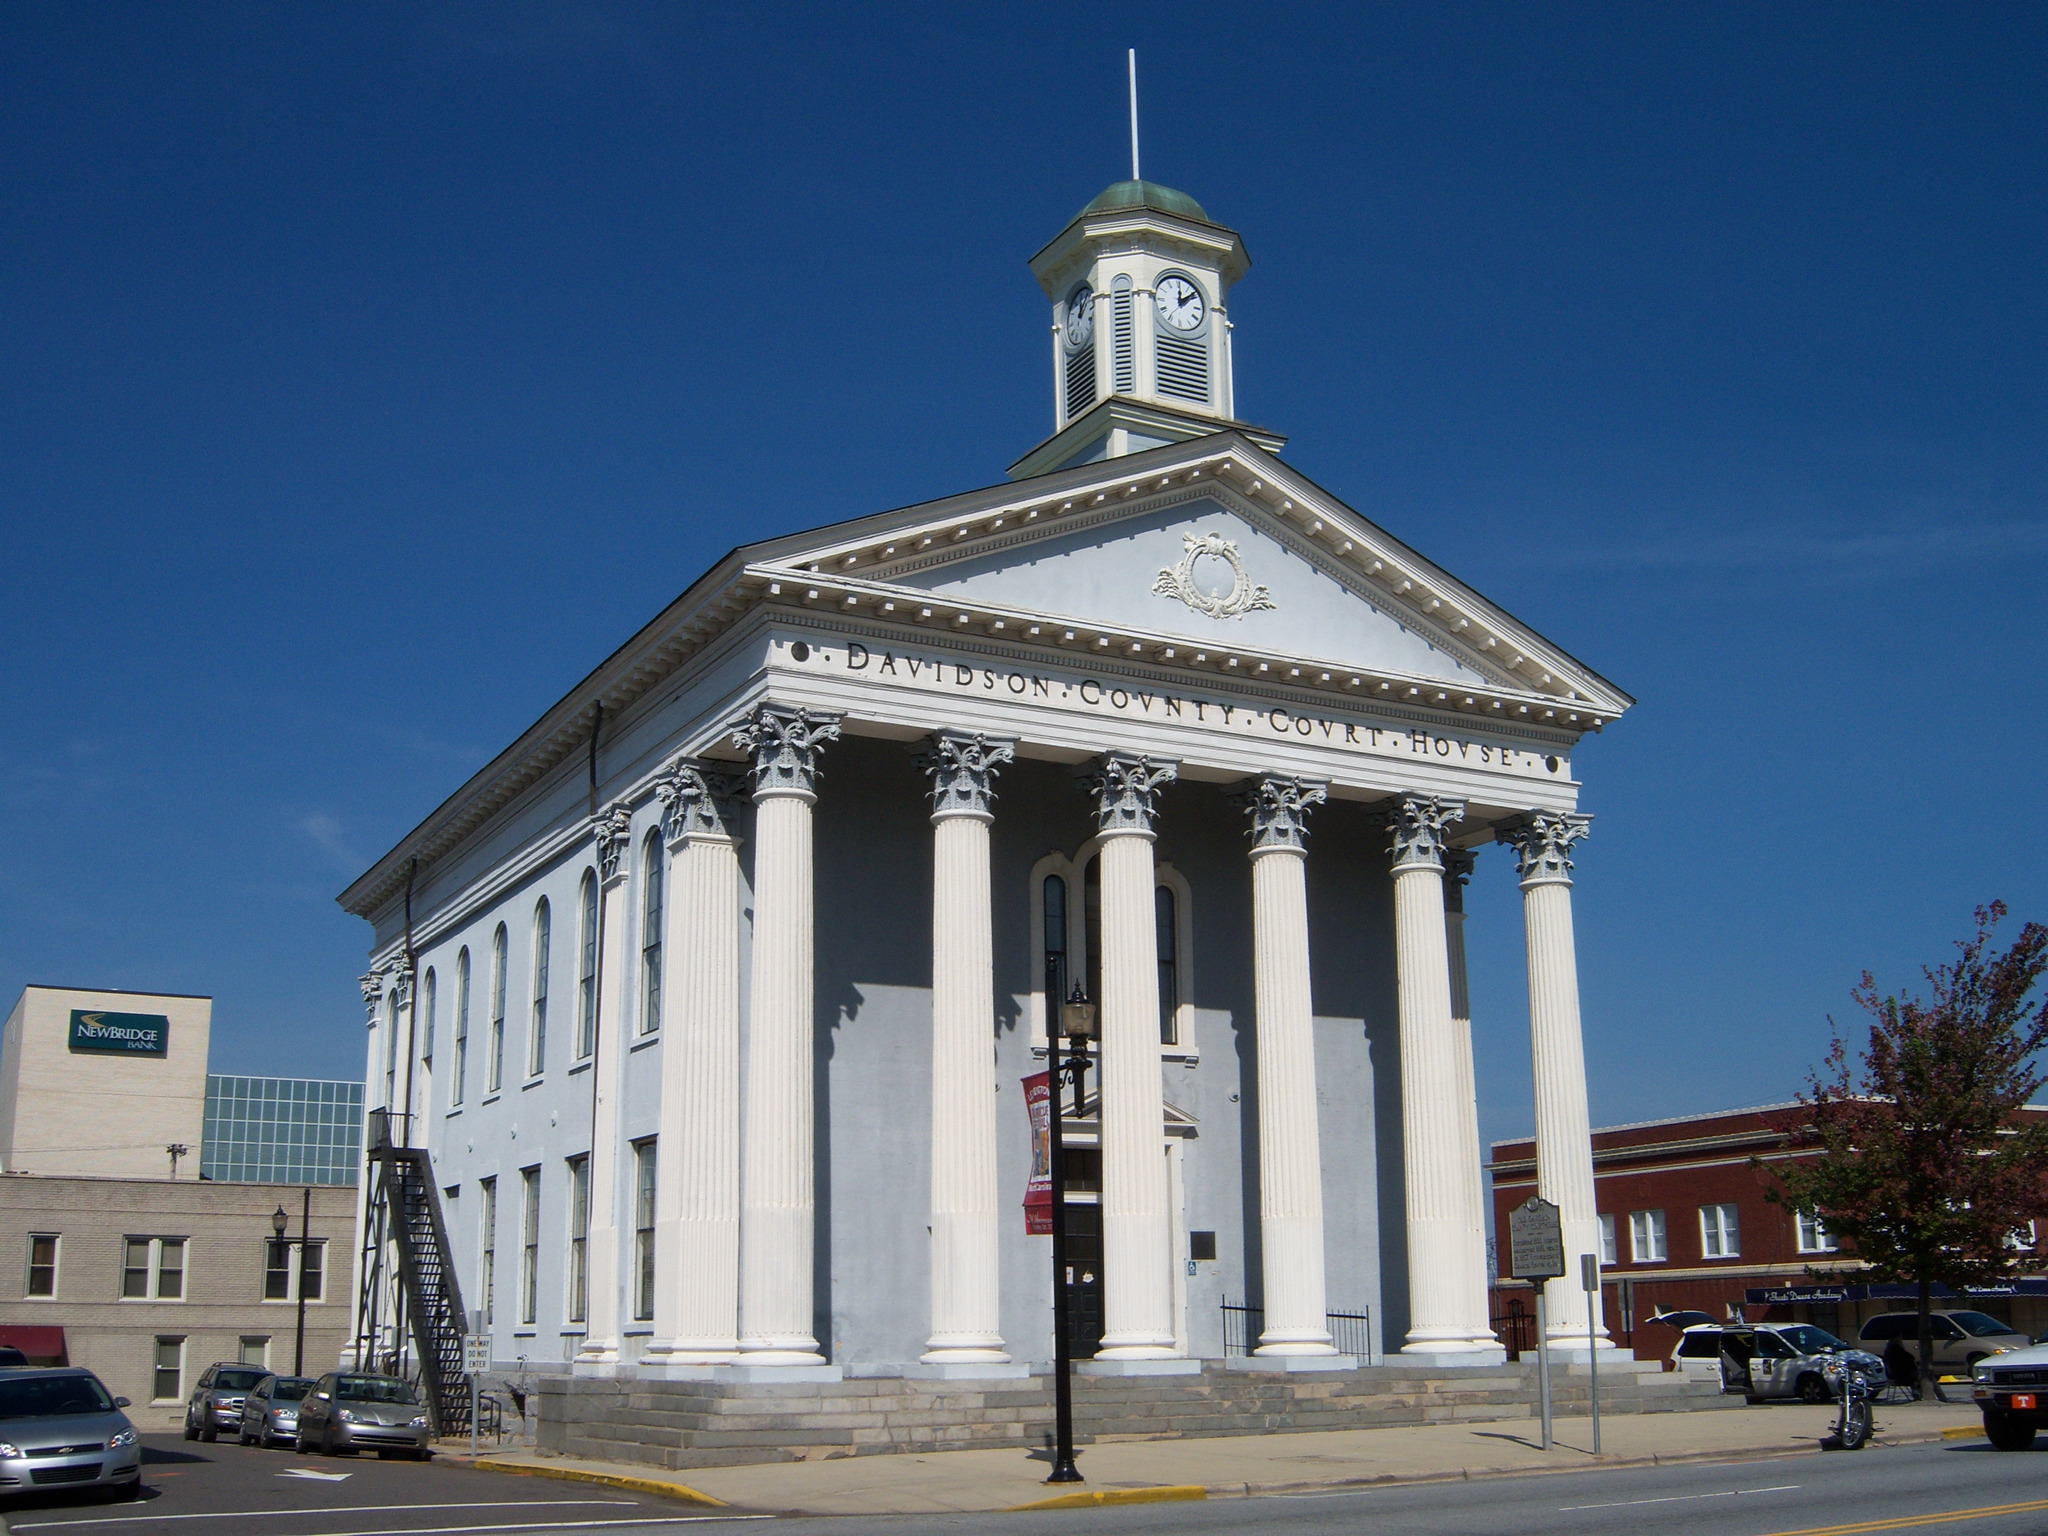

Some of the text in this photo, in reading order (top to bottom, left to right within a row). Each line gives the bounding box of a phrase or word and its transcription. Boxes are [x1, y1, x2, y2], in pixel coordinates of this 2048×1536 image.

[127, 1040, 157, 1049] BANK
[466, 1339, 490, 1348] ONE WAY
[468, 1350, 487, 1358] DO NOT
[469, 1360, 486, 1368] ENTER
[2017, 1396, 2030, 1408] T
